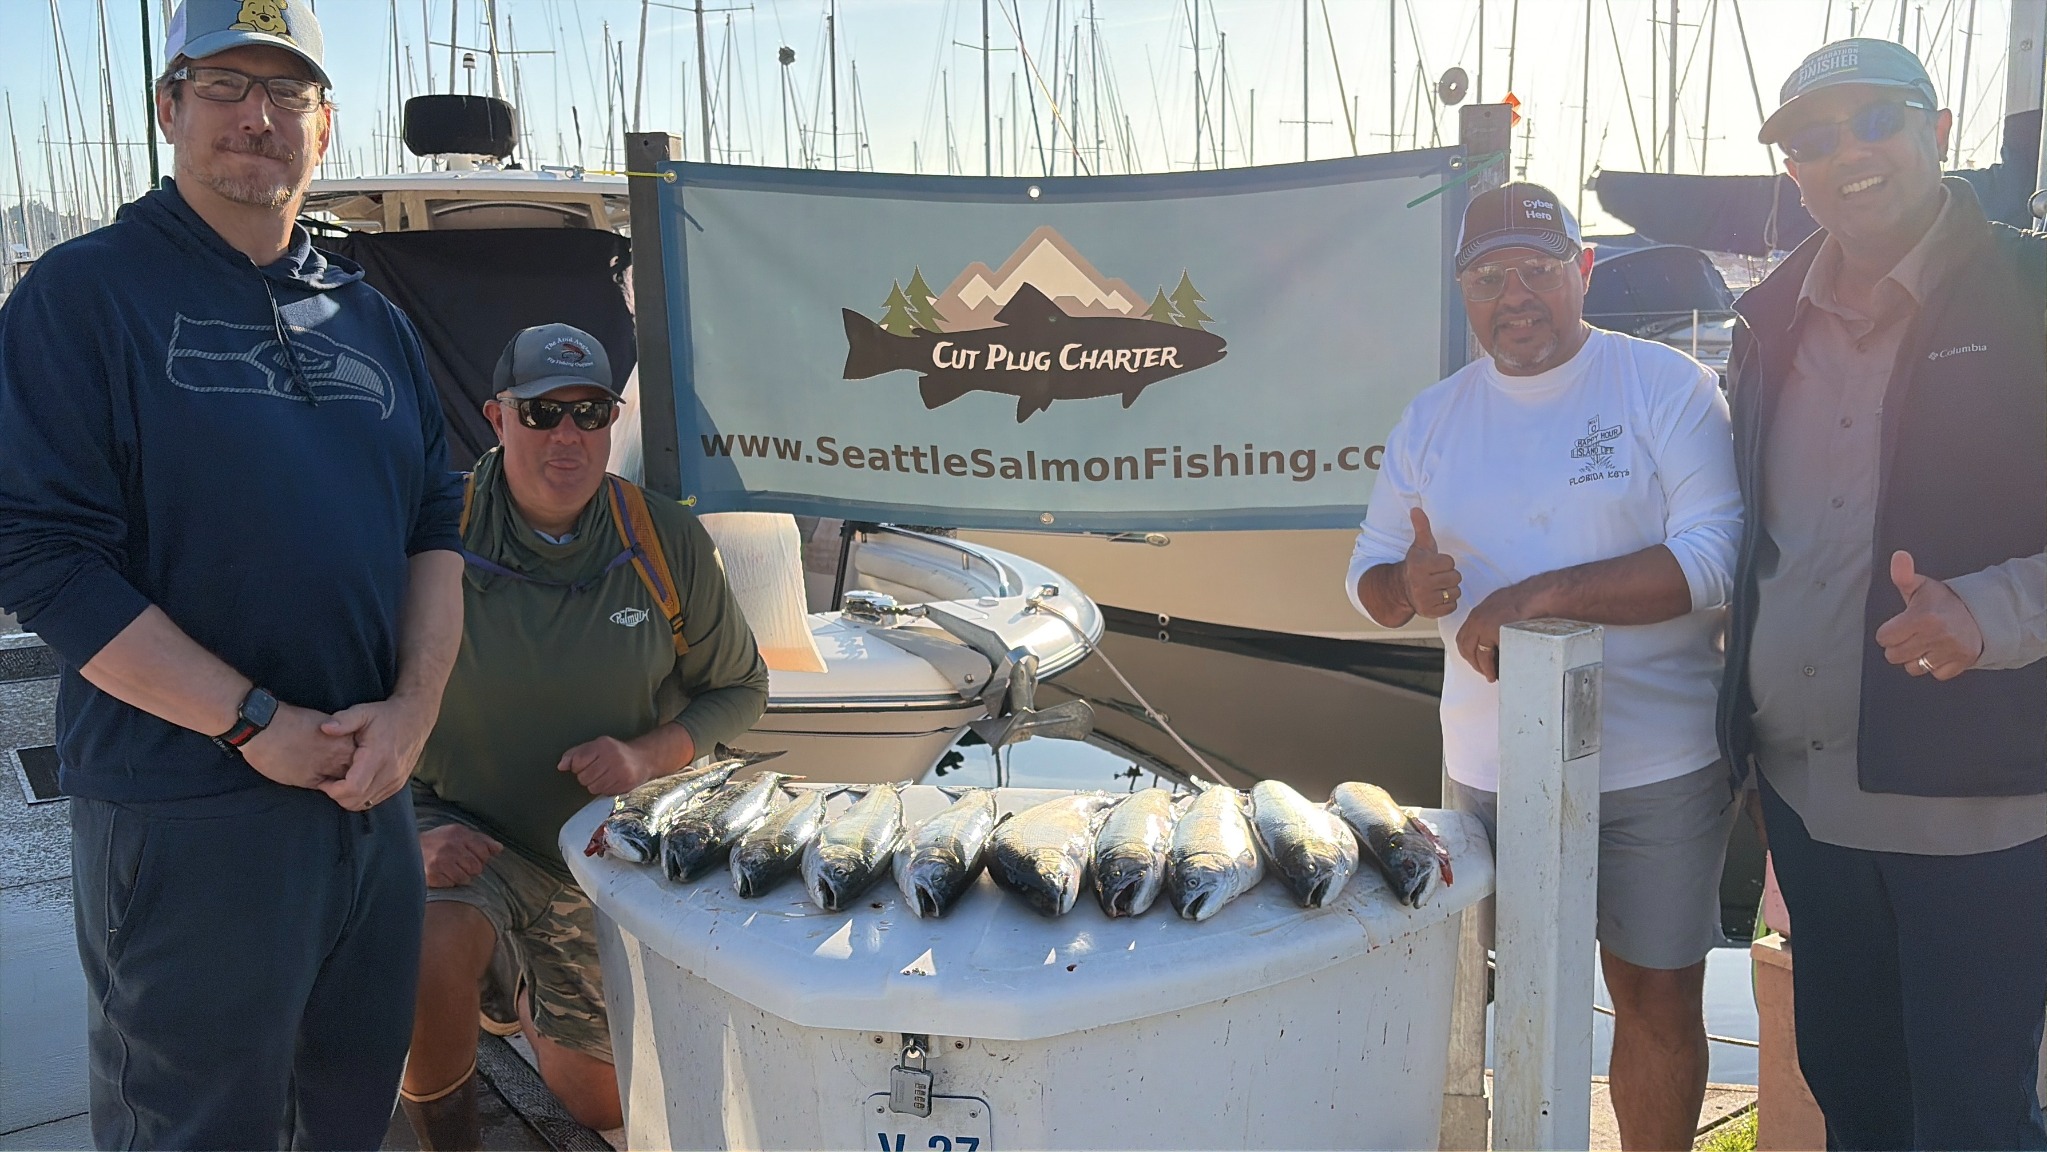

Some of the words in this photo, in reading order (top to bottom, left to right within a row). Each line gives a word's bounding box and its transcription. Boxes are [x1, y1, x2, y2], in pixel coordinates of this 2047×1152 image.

[1799, 54, 1858, 85] FINISHER
[1523, 199, 1553, 210] Cyber
[1526, 210, 1552, 221] Hero
[545, 341, 557, 350] The
[1939, 343, 1987, 358] Columbia
[932, 341, 981, 370] CUT
[985, 343, 1051, 371] PLUG
[1059, 343, 1183, 373] CHARTER
[1577, 433, 1599, 447] HAPPY
[1600, 428, 1618, 439] HOUR
[1569, 472, 1604, 486] FLORIDA
[1607, 469, 1630, 479] KEYS
